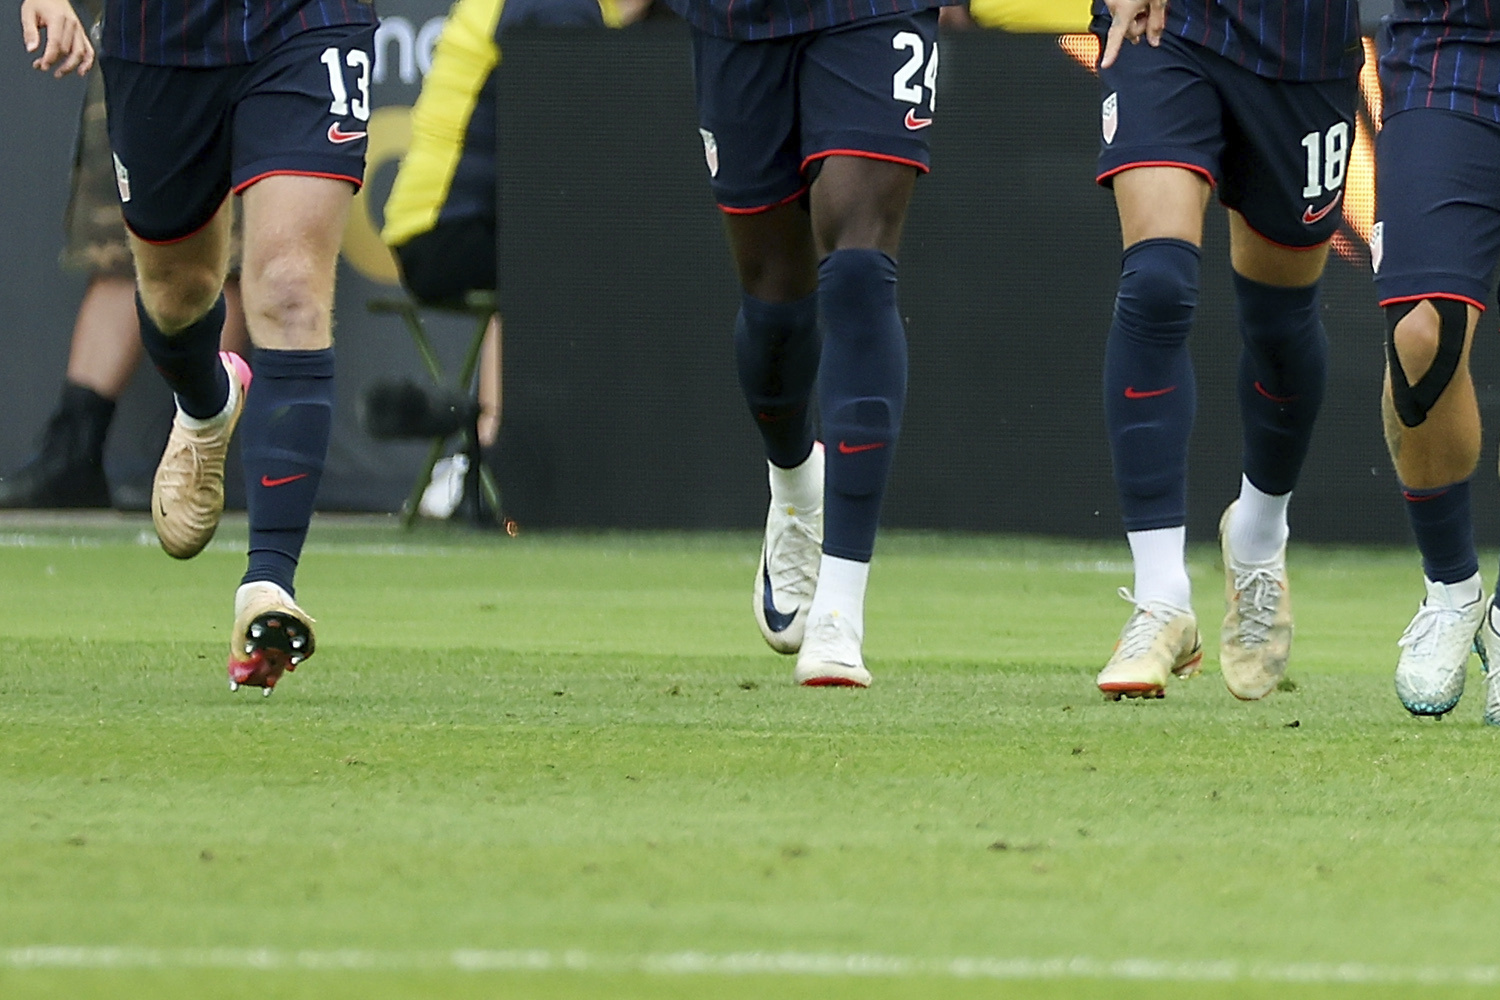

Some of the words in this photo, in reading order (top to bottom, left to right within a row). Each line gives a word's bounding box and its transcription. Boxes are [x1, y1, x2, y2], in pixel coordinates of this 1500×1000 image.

[320, 47, 371, 121] 13
[892, 31, 939, 113] 24
[1301, 121, 1349, 199] 18
